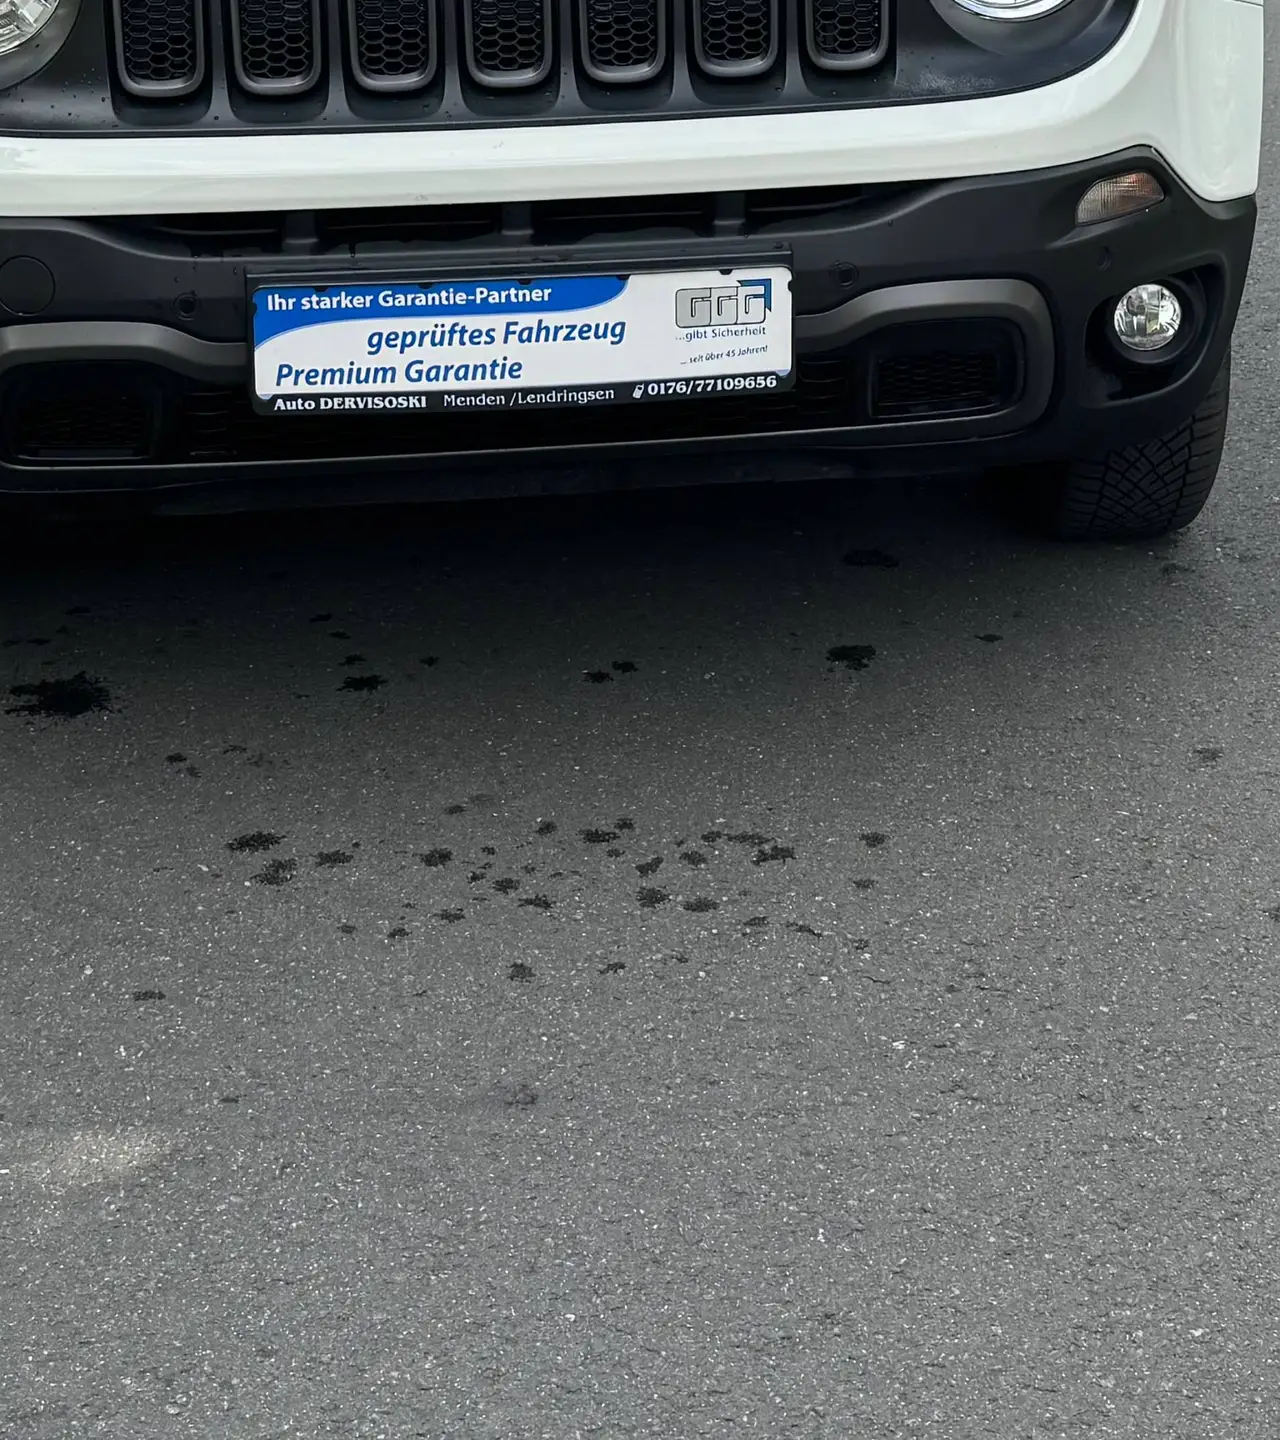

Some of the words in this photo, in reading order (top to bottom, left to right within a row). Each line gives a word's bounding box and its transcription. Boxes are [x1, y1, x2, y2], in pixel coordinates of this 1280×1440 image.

[267, 294, 296, 311] Ihr
[301, 291, 373, 310] starker
[378, 286, 552, 307] Garantie-Partner
[367, 322, 496, 355] geprüftes
[503, 319, 626, 345] Fahrzeug
[711, 326, 766, 338] Sicherheit
[725, 348, 735, 357] 45
[276, 360, 396, 387] Premium
[404, 356, 523, 382] Garantie
[647, 375, 777, 396] 0176/77109656
[274, 397, 316, 410] Auto
[320, 396, 427, 410] DERVISOSKI
[443, 392, 505, 407] Menden
